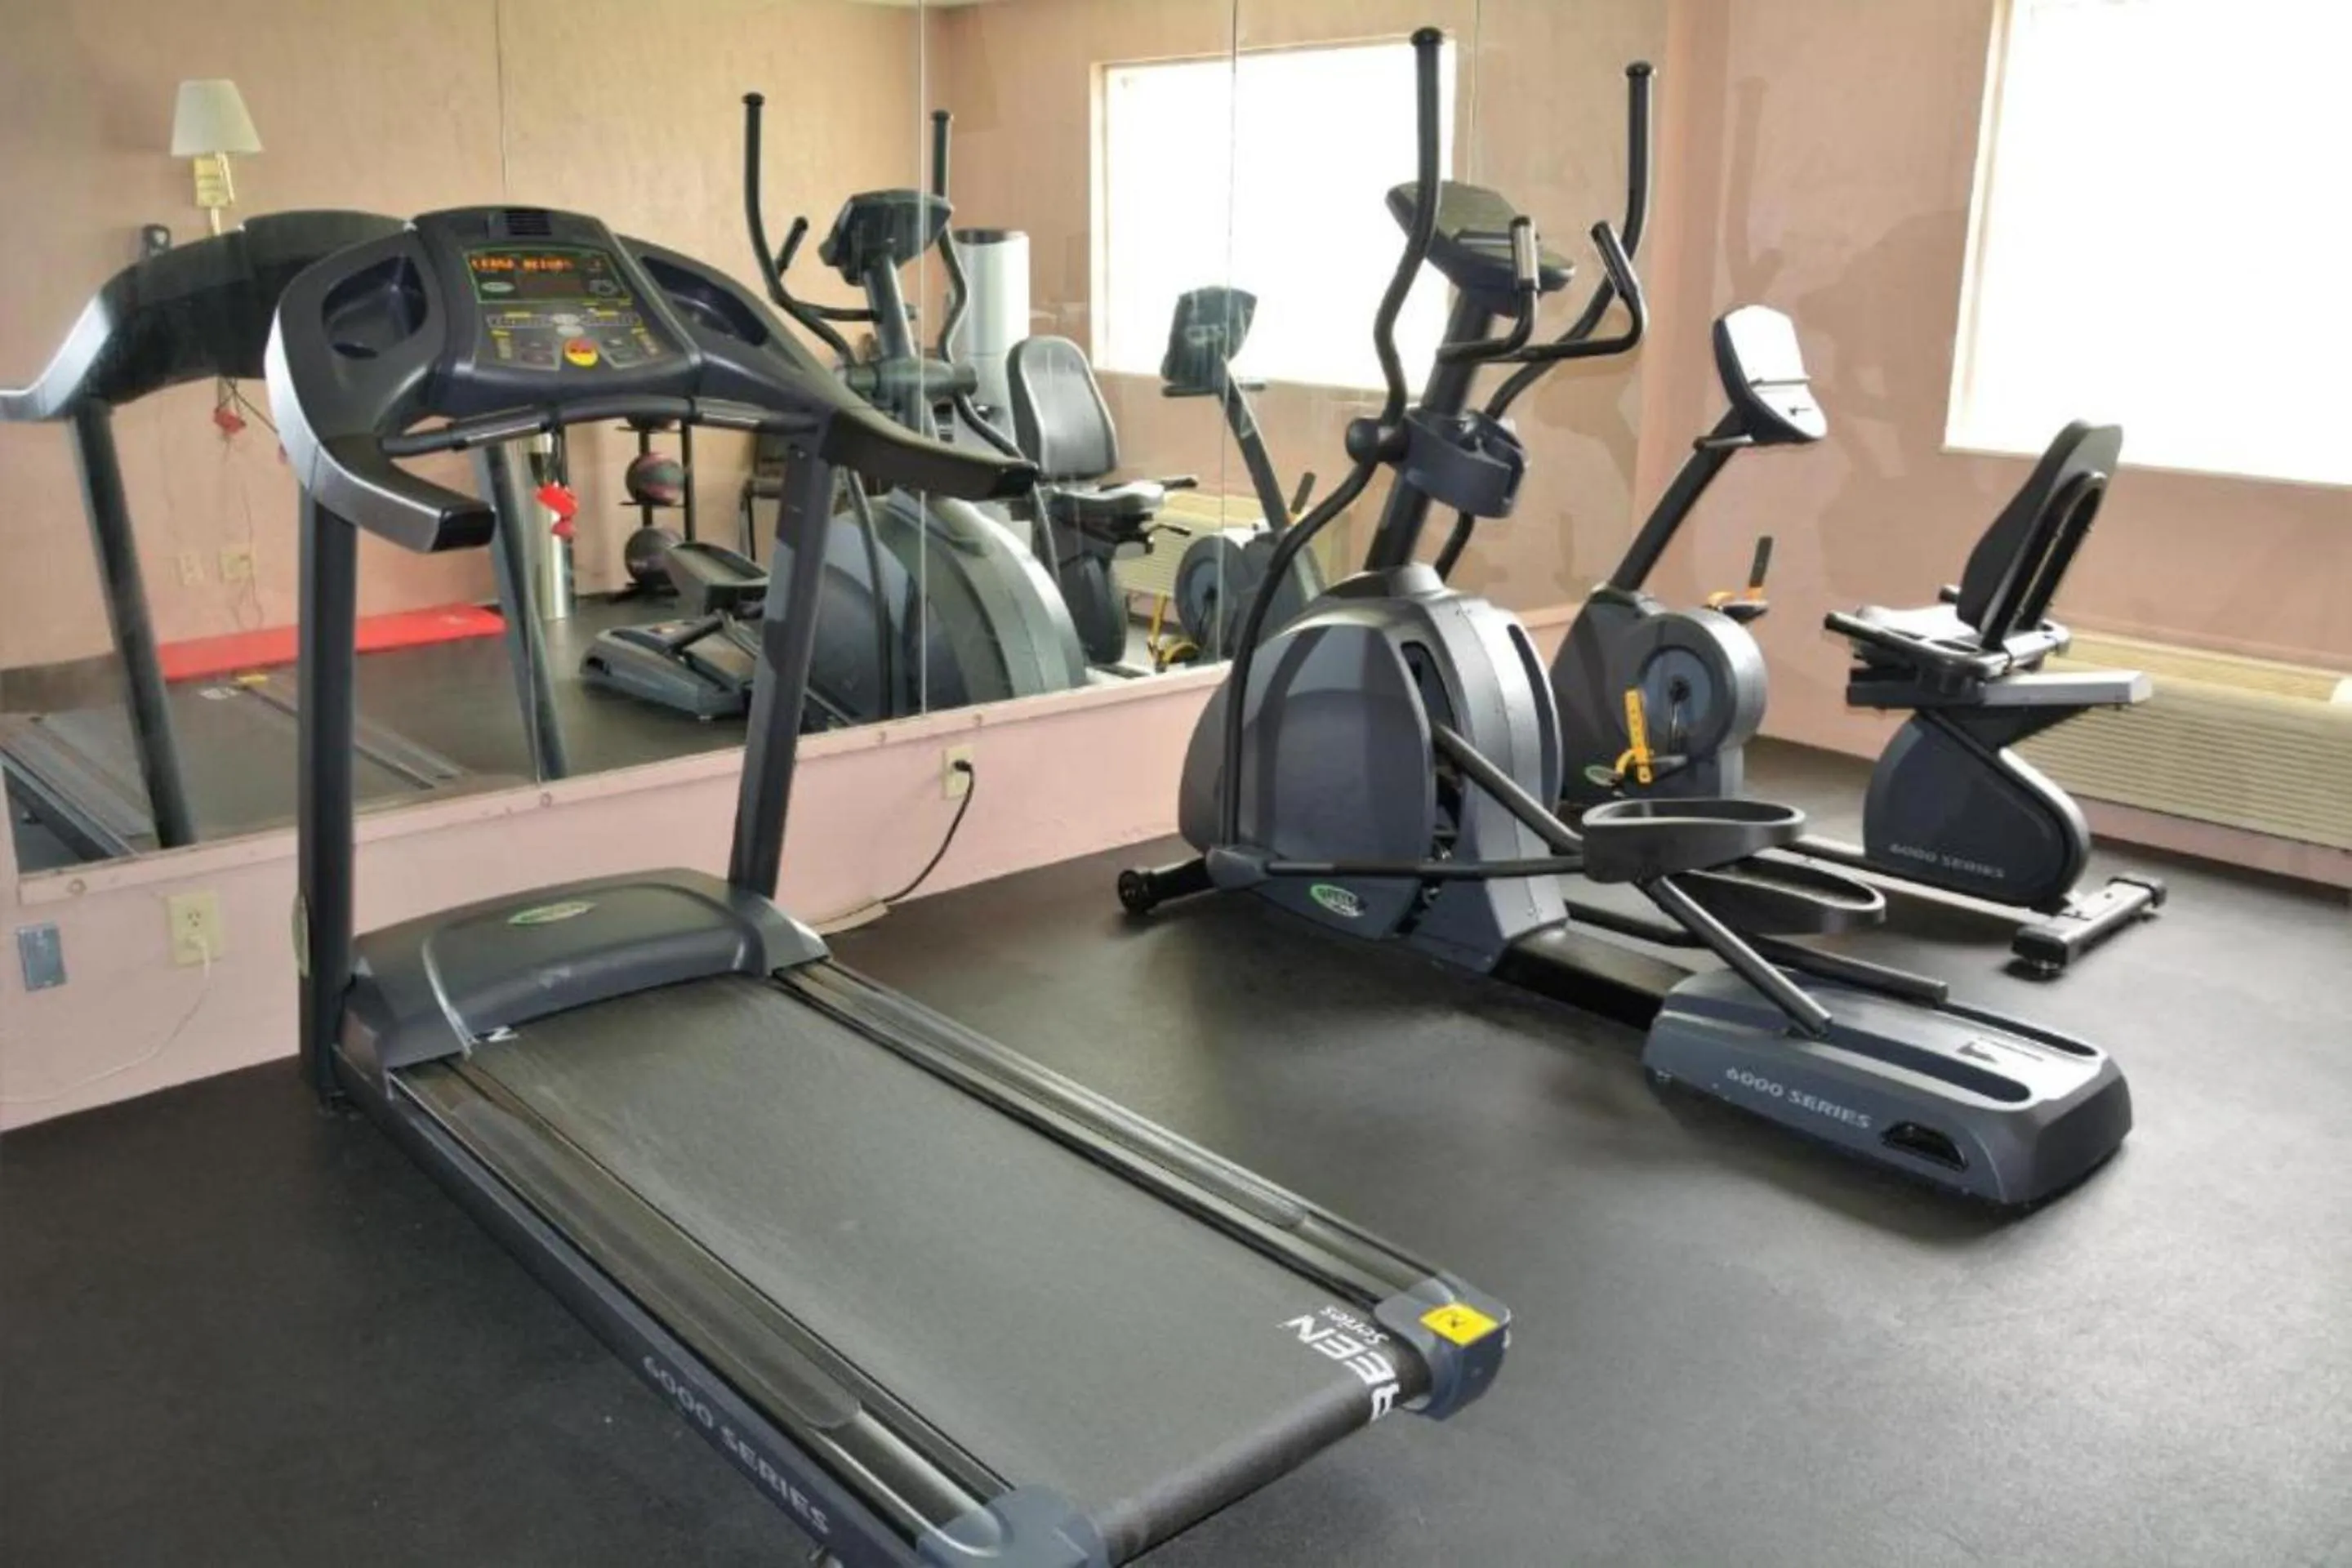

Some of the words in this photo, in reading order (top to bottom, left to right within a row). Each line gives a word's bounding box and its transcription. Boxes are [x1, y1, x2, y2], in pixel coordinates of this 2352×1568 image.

[1889, 844, 1937, 863] 6000
[1940, 855, 2005, 879] SERIES
[1726, 1067, 1784, 1097] 6000
[1788, 1089, 1873, 1128] SERIES
[1320, 1306, 1389, 1346] Series
[643, 1356, 714, 1428] 6000
[719, 1425, 830, 1535] SERIES
